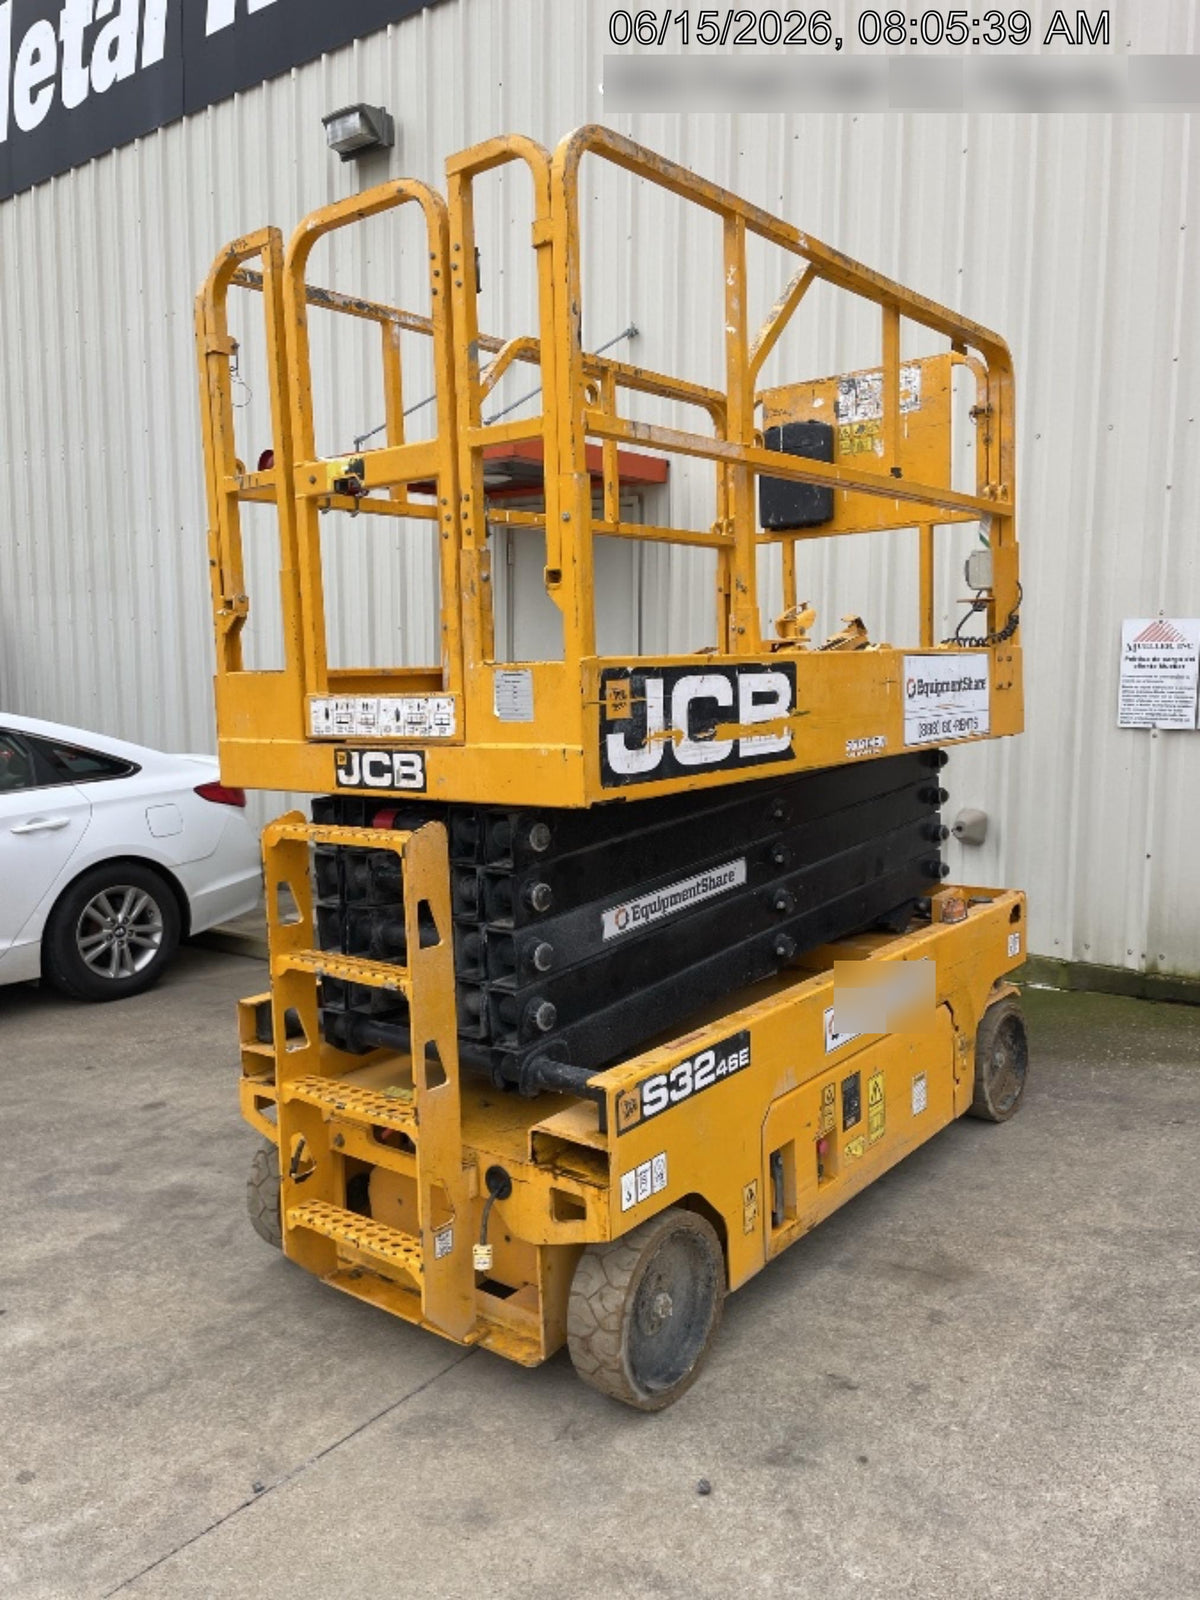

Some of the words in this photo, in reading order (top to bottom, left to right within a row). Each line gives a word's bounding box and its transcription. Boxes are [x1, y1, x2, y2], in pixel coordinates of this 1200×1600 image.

[0, 0, 166, 143] etal
[917, 677, 987, 698] EquipmentShare
[606, 672, 792, 774] JCB
[338, 751, 424, 789] JCB
[631, 869, 736, 922] EquipmentShare
